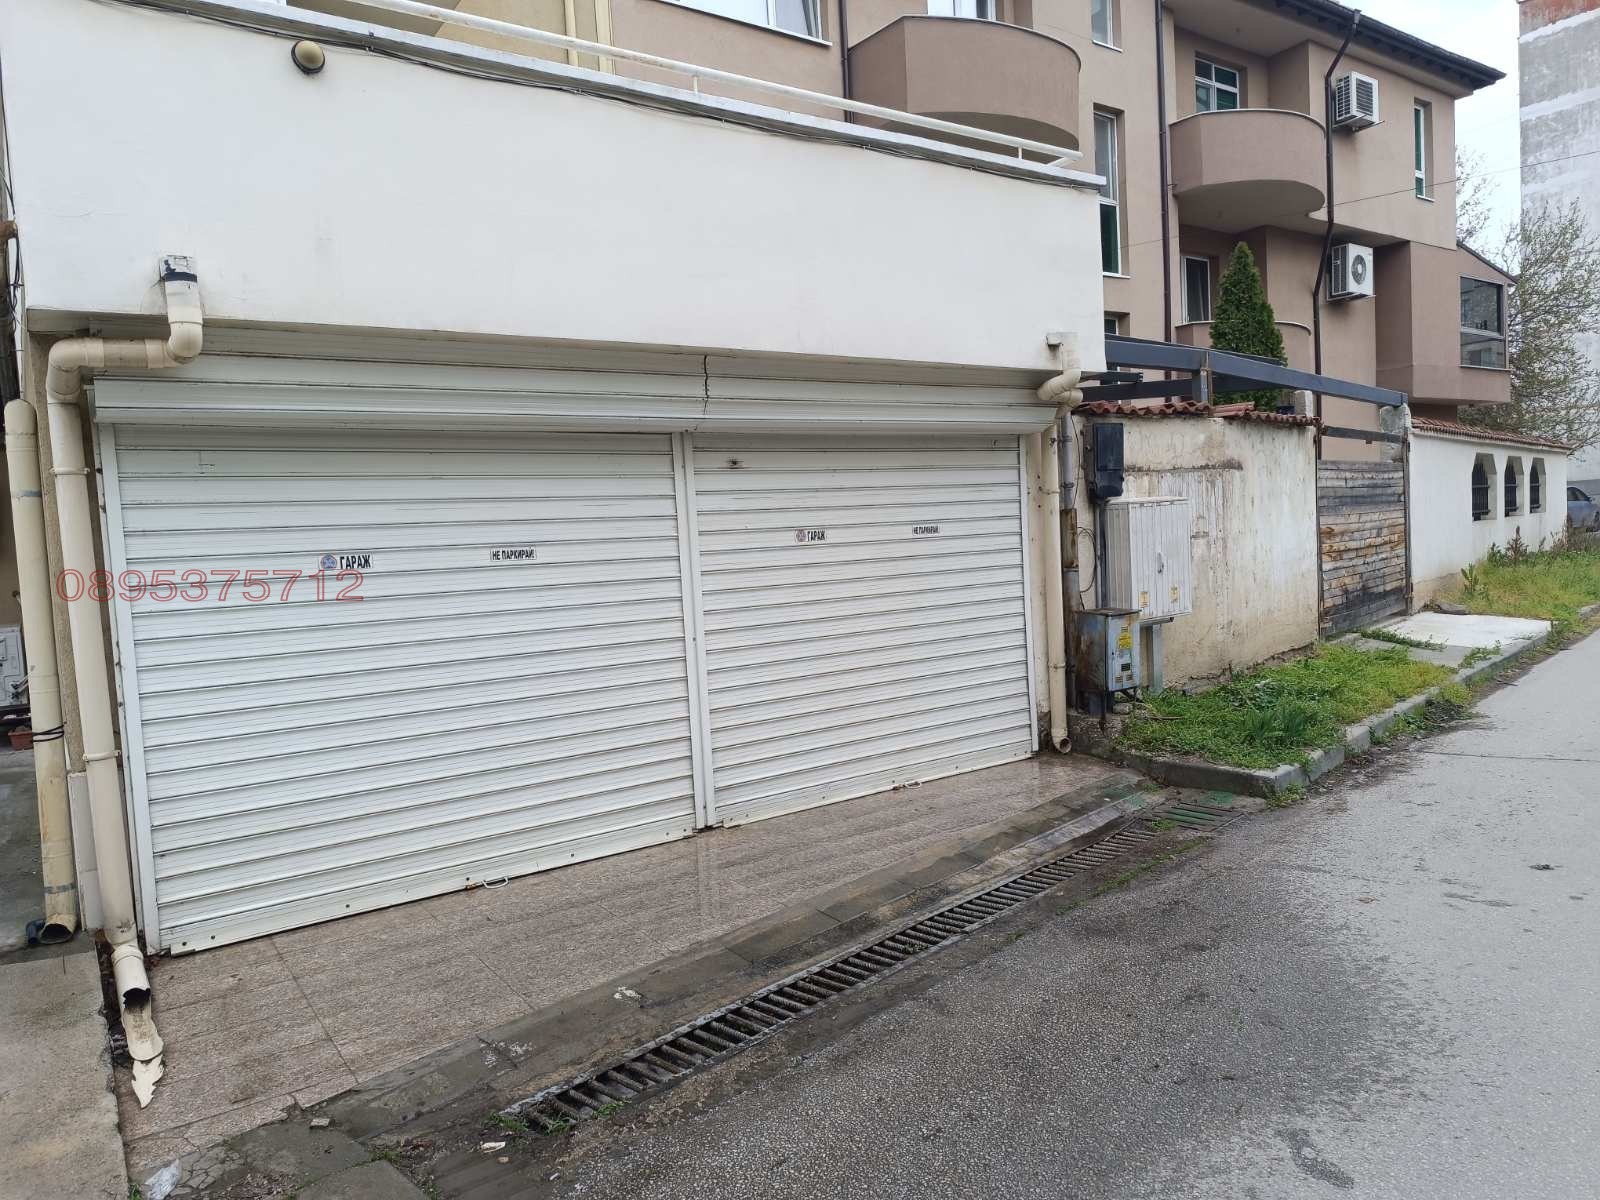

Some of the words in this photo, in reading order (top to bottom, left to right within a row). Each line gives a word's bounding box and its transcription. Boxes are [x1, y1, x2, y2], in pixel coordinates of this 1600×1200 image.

[807, 530, 826, 542] ГАРАЖ
[492, 550, 501, 560] НЕ
[339, 554, 372, 570] ГАРАЖ
